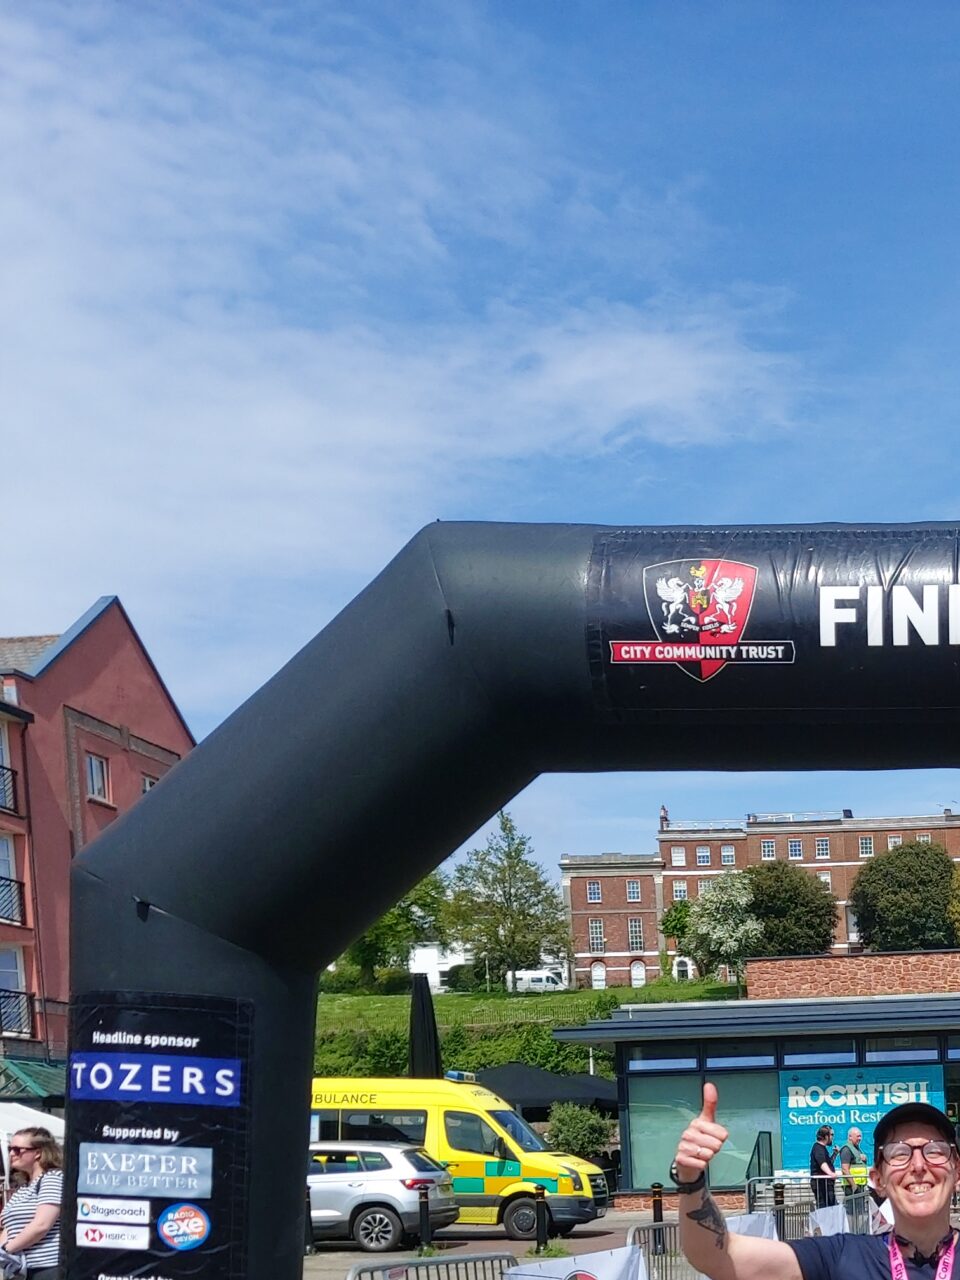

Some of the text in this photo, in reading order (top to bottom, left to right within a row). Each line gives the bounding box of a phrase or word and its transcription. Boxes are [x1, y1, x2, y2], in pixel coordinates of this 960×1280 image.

[620, 645, 785, 659] CITY COMMUNITY TRUST
[92, 1030, 200, 1049] Headline sponsor
[72, 1062, 235, 1096] TOZERS
[312, 1093, 378, 1105] BULANCE
[787, 1081, 931, 1109] ROCKFISH
[788, 1110, 846, 1126] Seafood
[102, 1125, 180, 1142] Supported by
[87, 1151, 199, 1175] EXETER
[86, 1172, 199, 1189] LIVE BETTER
[90, 1204, 146, 1217] Stagecoach
[162, 1217, 204, 1236] exe
[894, 1263, 904, 1280] City
